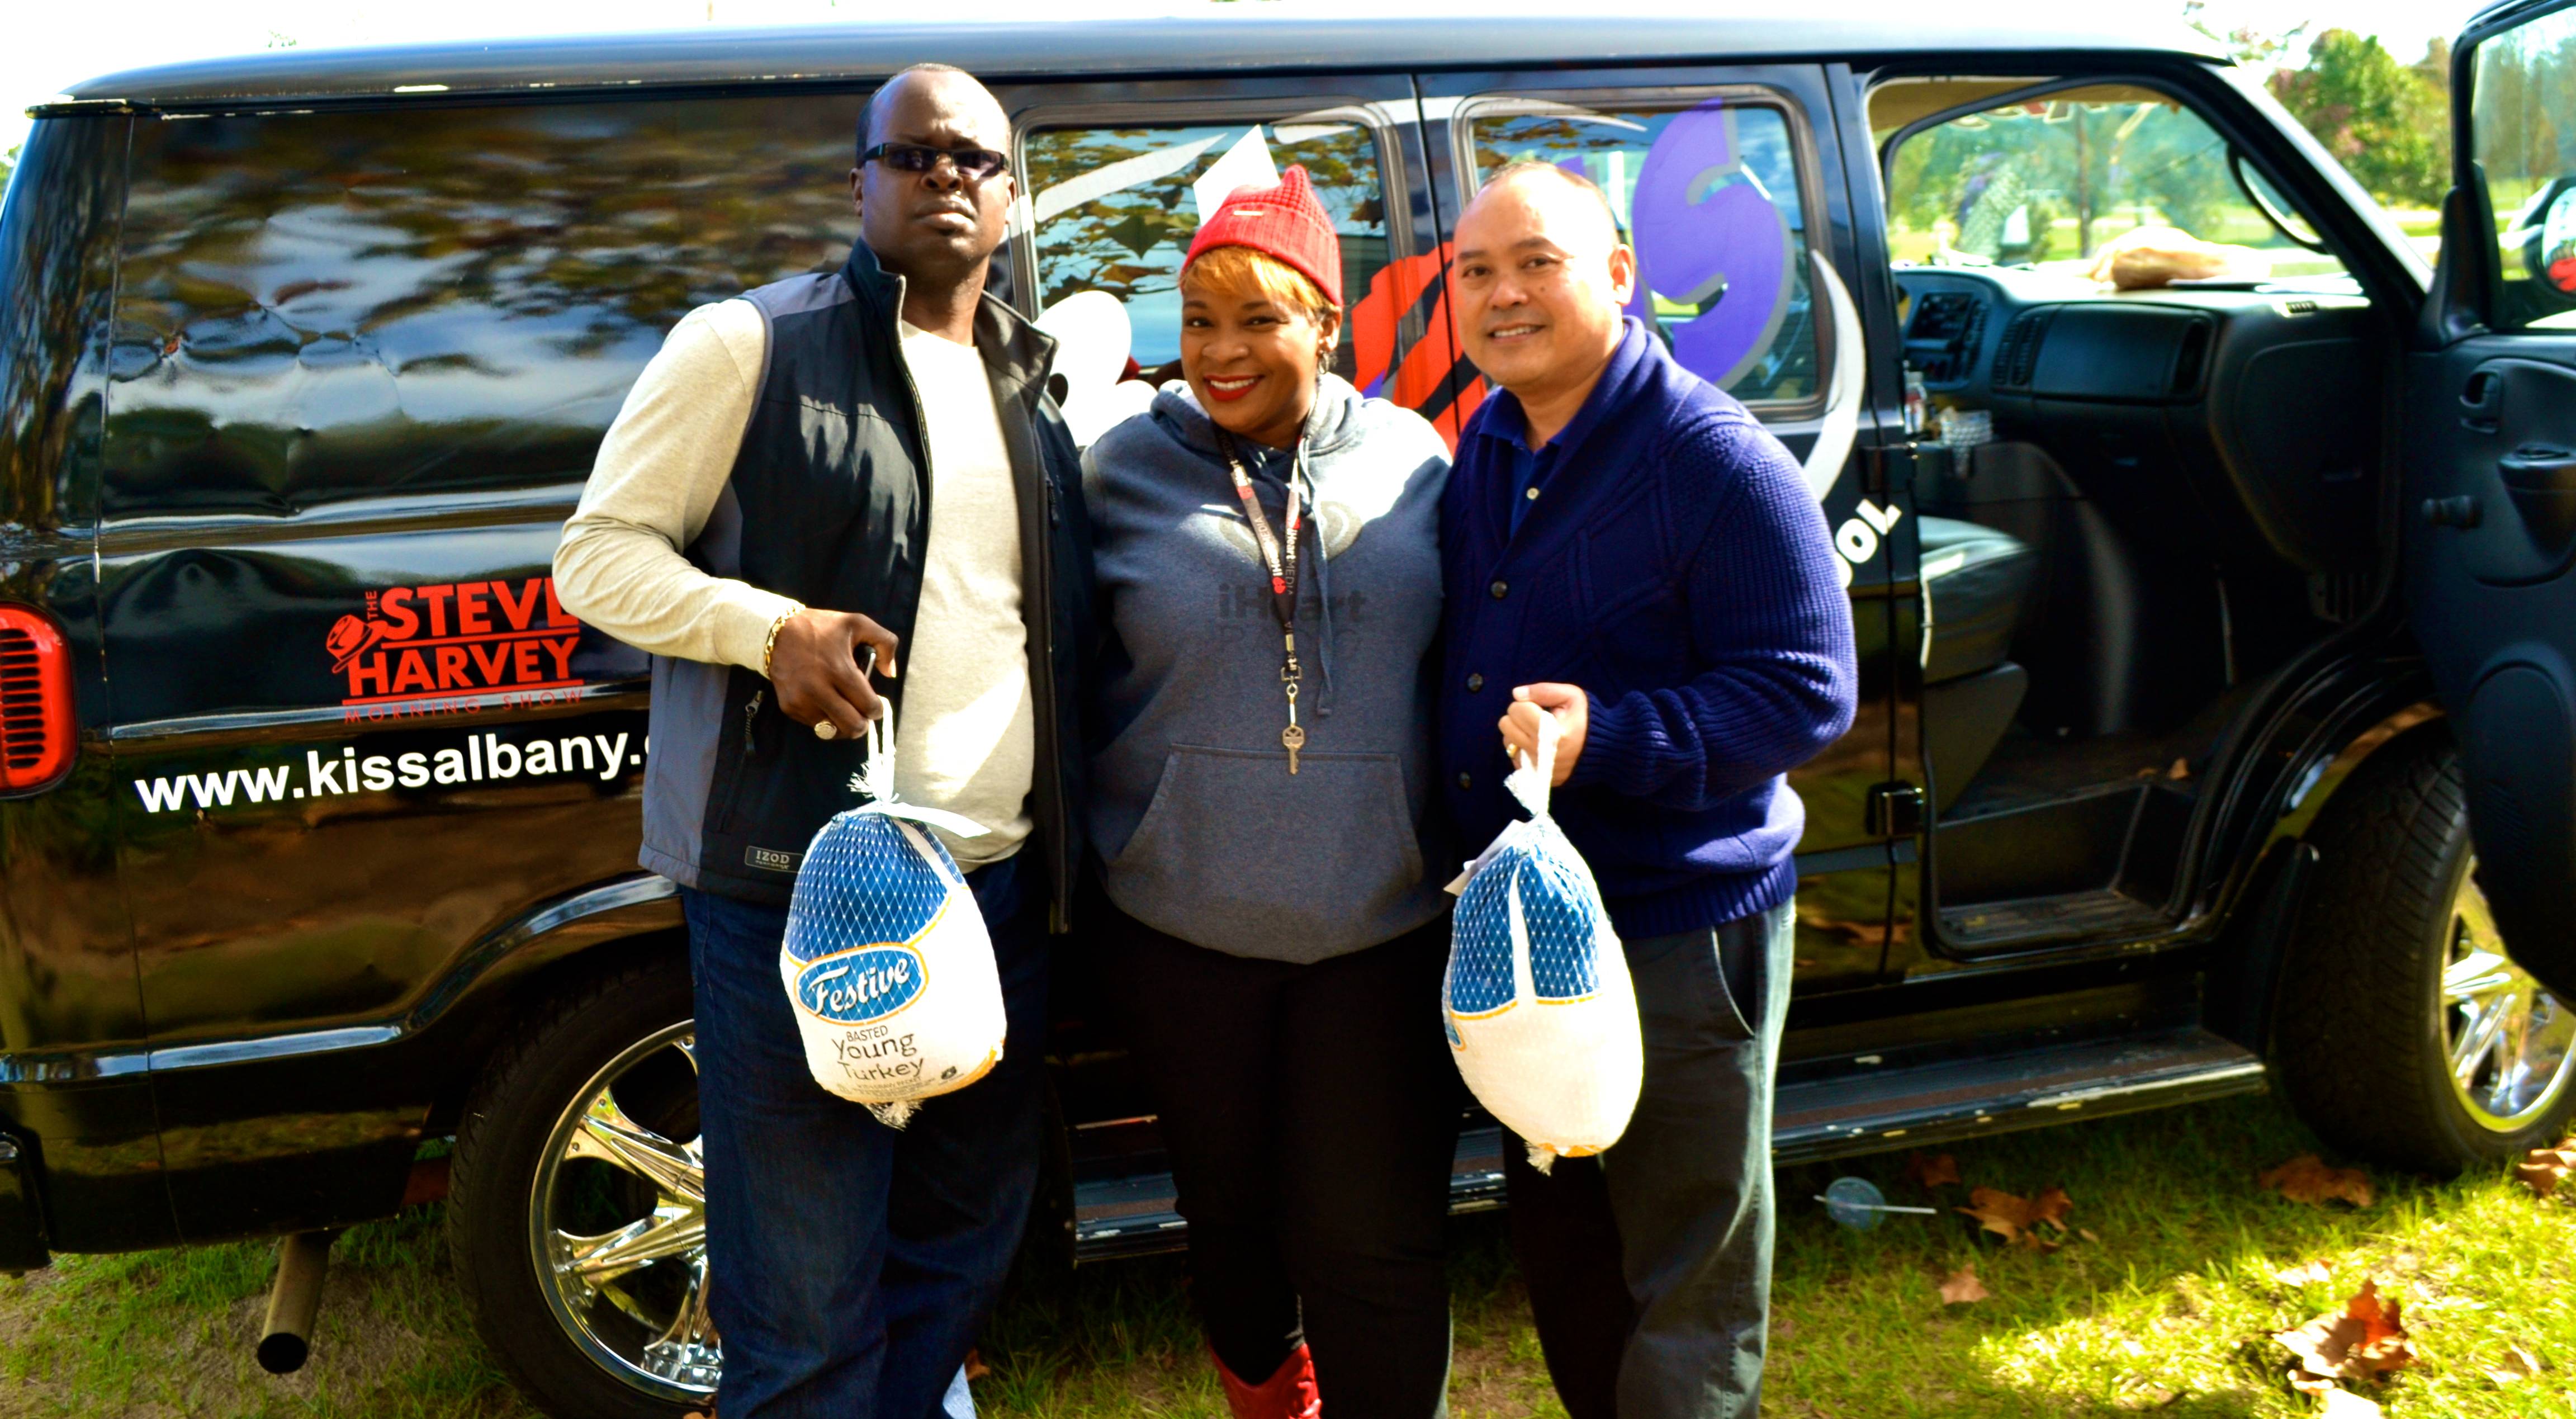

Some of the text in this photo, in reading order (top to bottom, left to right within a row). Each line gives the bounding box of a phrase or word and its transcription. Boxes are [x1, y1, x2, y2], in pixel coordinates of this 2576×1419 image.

[365, 590, 378, 621] THE
[348, 637, 580, 696] HARVEY
[344, 689, 583, 724] MORNING SHOW
[134, 732, 650, 813] www.kissalbany.
[756, 850, 789, 864] IZOD
[807, 958, 911, 1016] Festive
[832, 1033, 918, 1060] Young
[846, 1025, 888, 1042] BASTED
[837, 1058, 925, 1081] Turkey
